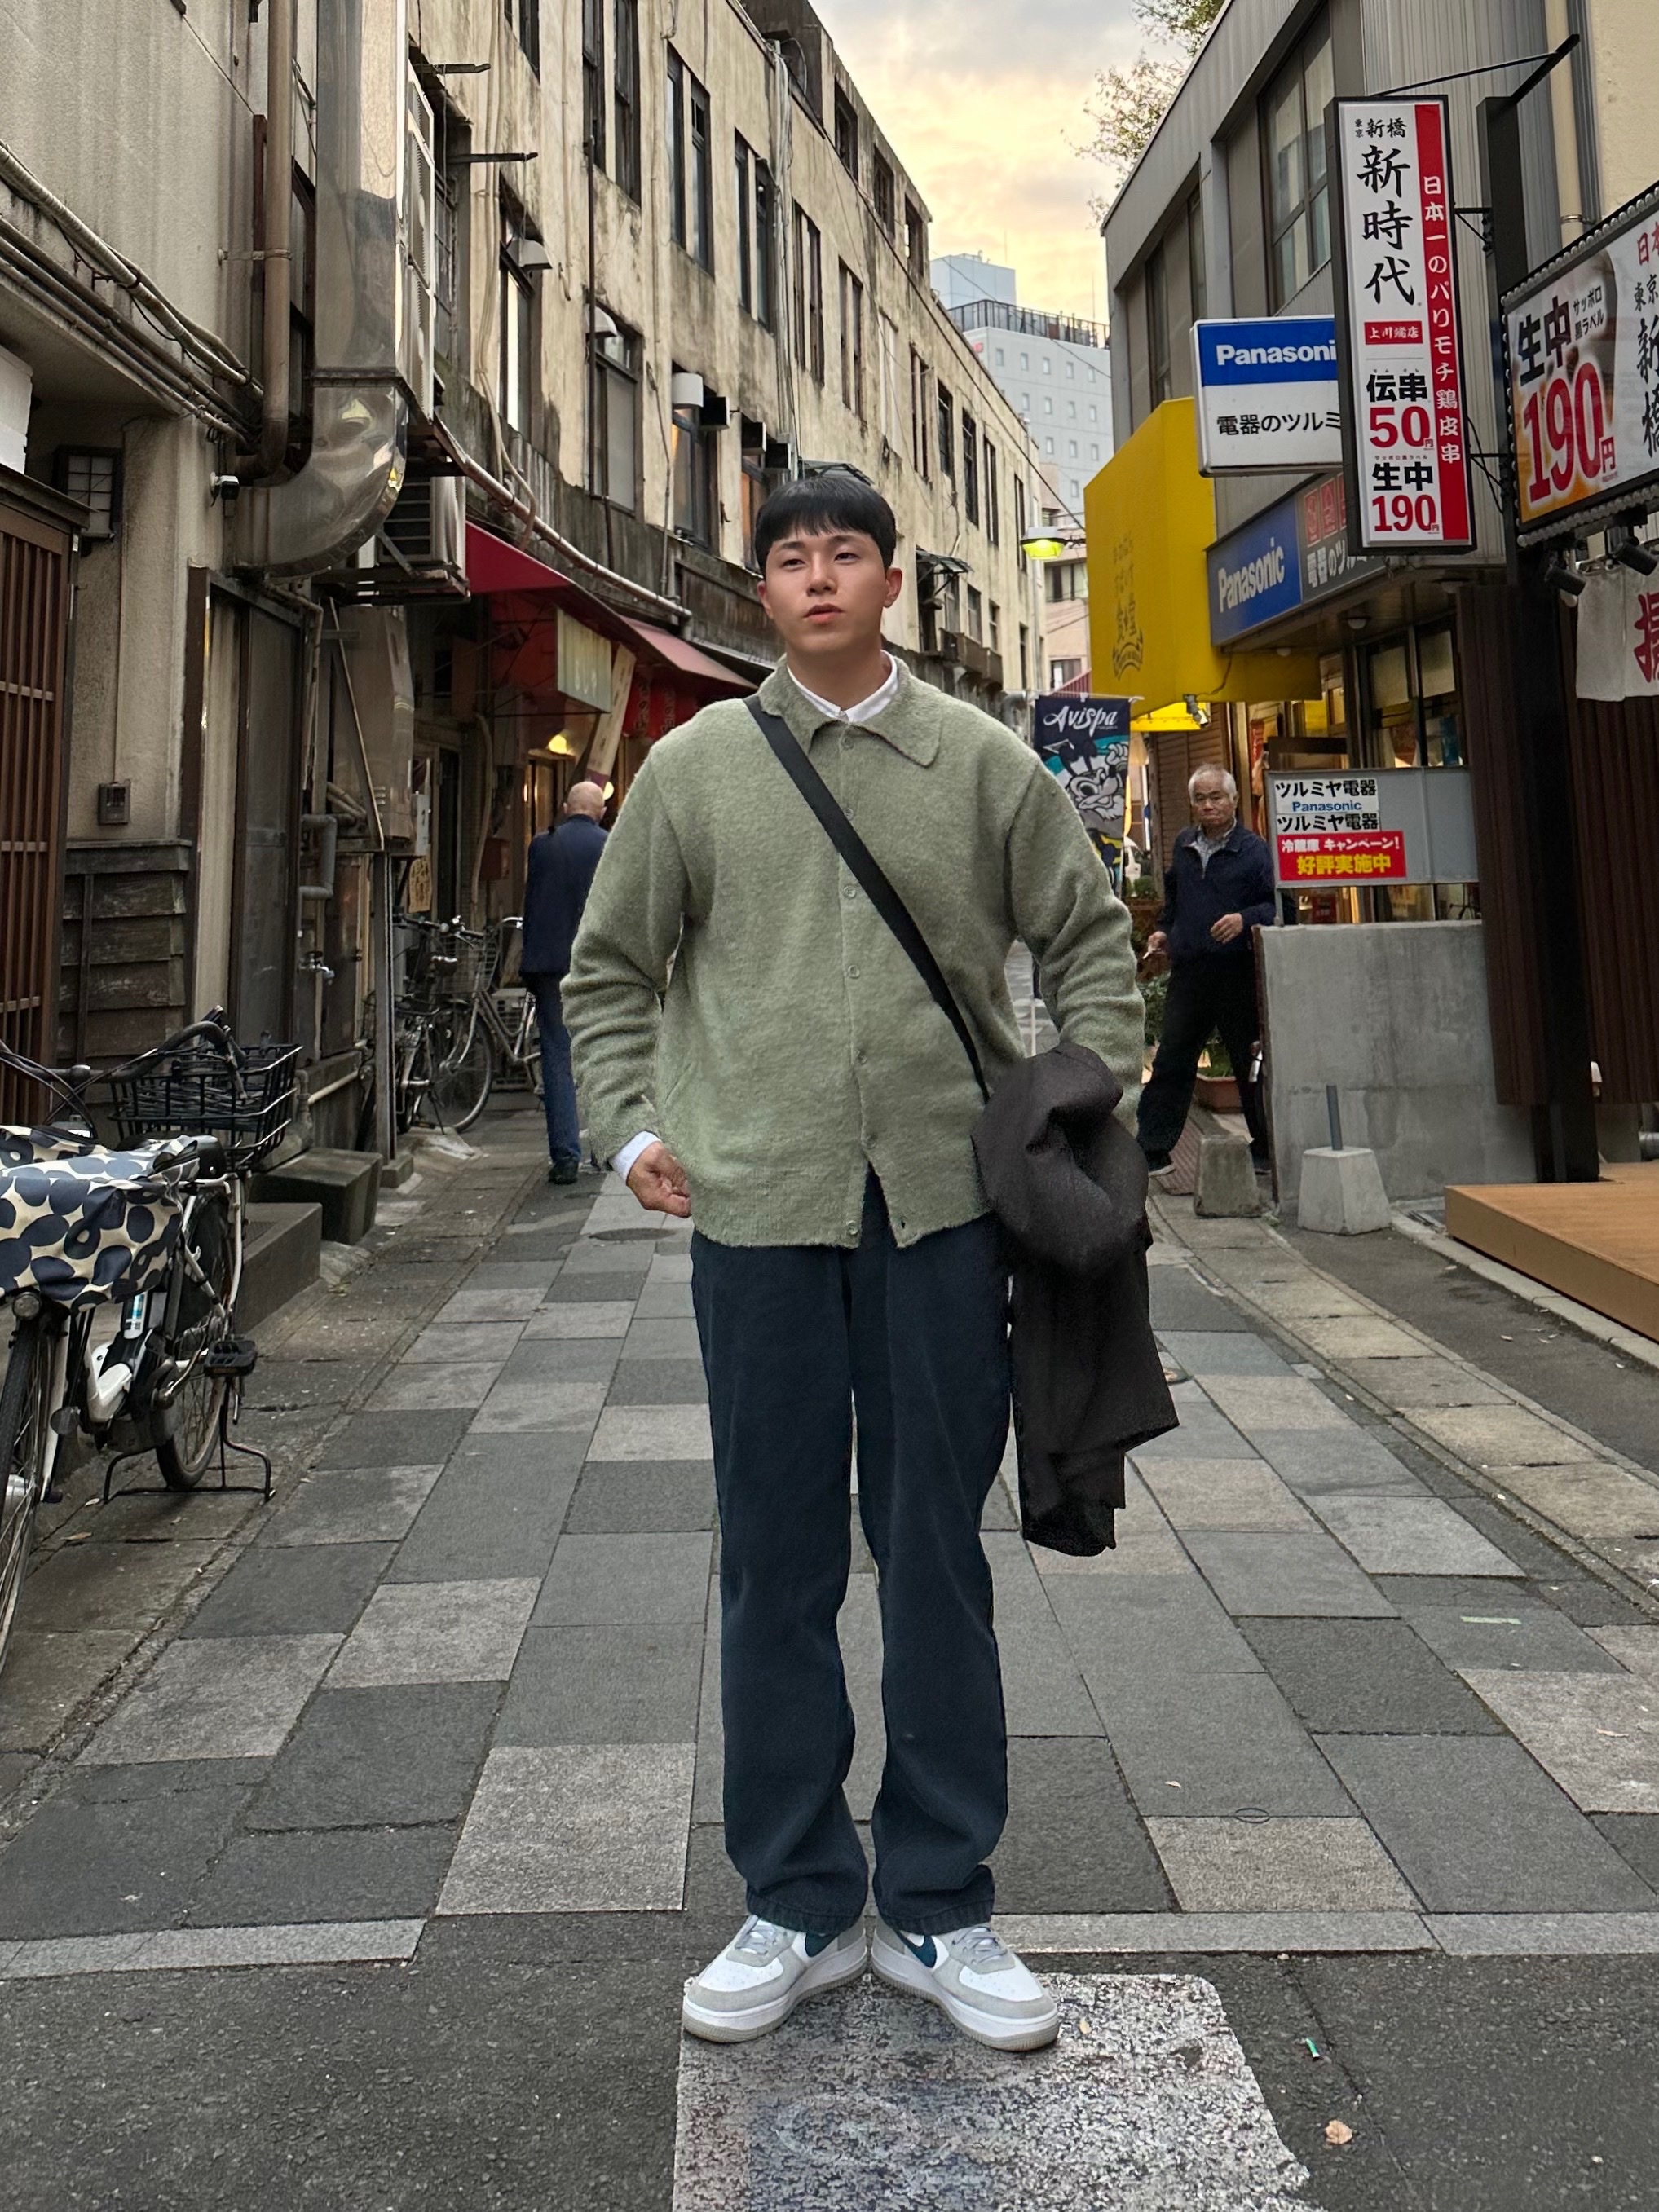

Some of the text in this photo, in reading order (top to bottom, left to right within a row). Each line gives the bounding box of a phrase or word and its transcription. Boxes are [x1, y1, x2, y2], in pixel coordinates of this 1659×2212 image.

[1366, 117, 1407, 138] 新橋
[1356, 144, 1415, 306] 新時代
[1573, 285, 1603, 316] サッポロ
[1369, 326, 1419, 339] 上川端店
[1574, 308, 1604, 341] 黒ラベル
[1517, 295, 1572, 386] 生中
[1366, 372, 1427, 403] 伝串
[1371, 461, 1433, 491] 生中
[1218, 536, 1285, 613] Panasonic
[1275, 779, 1377, 798] ツルミヤ電器
[1292, 800, 1362, 813] Panasonic
[1277, 813, 1379, 832] ツルミヤ電器
[1297, 853, 1392, 875] 好評実施中
